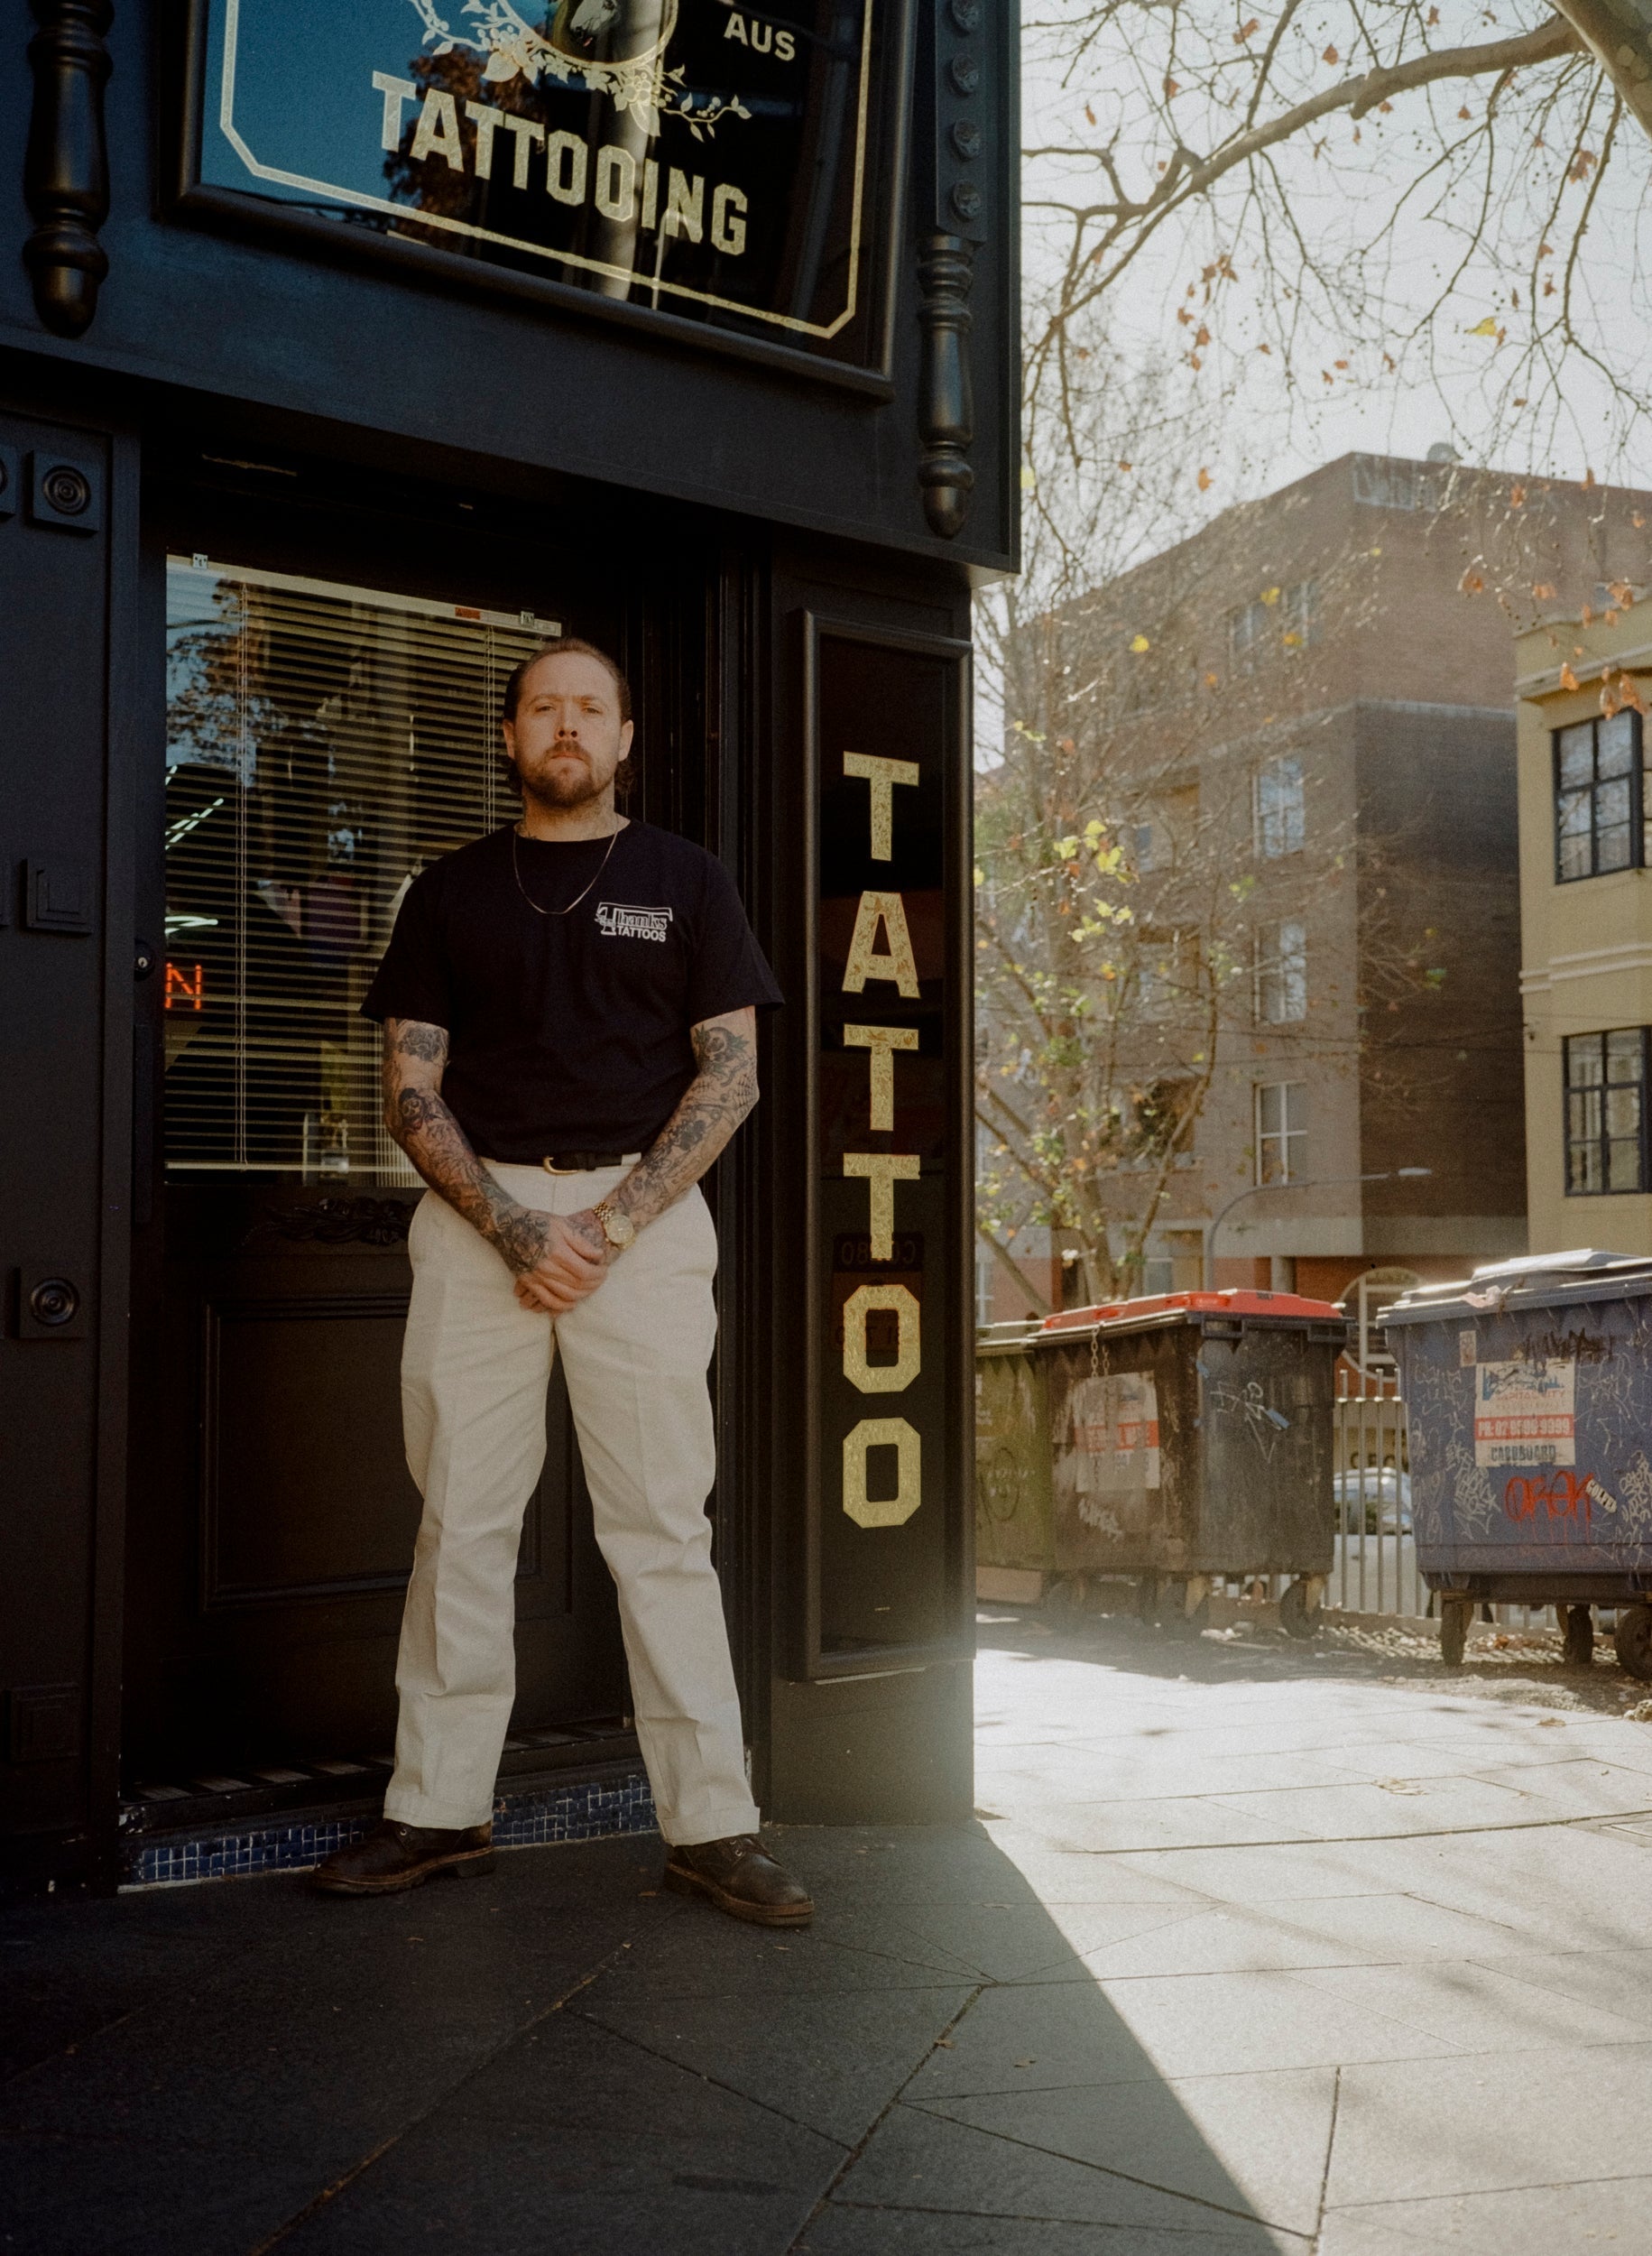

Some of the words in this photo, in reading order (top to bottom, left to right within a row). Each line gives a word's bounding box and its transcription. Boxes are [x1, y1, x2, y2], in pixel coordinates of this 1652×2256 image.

[723, 12, 797, 62] AUS
[372, 70, 748, 256] TATTOOING
[617, 925, 667, 942] TATTOOS
[842, 750, 922, 1529] TATTOO
